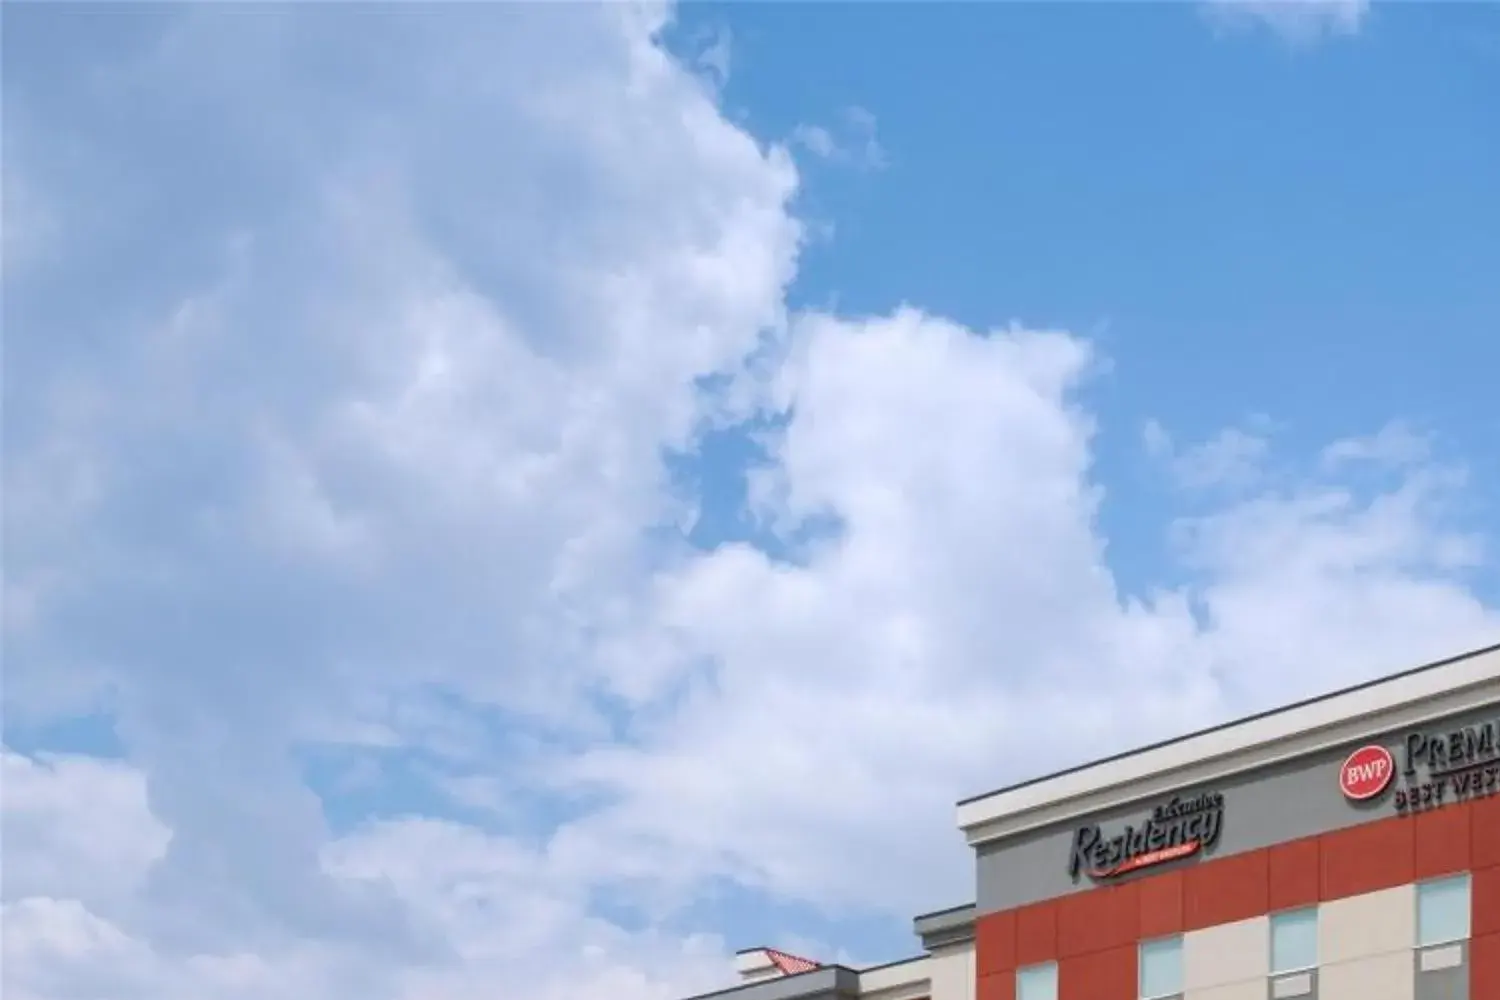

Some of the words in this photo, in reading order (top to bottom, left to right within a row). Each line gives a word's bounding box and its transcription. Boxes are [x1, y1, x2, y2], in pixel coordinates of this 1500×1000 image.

[1346, 758, 1387, 785] BWP
[1395, 781, 1445, 811] BEST
[1069, 810, 1223, 878] Residency
